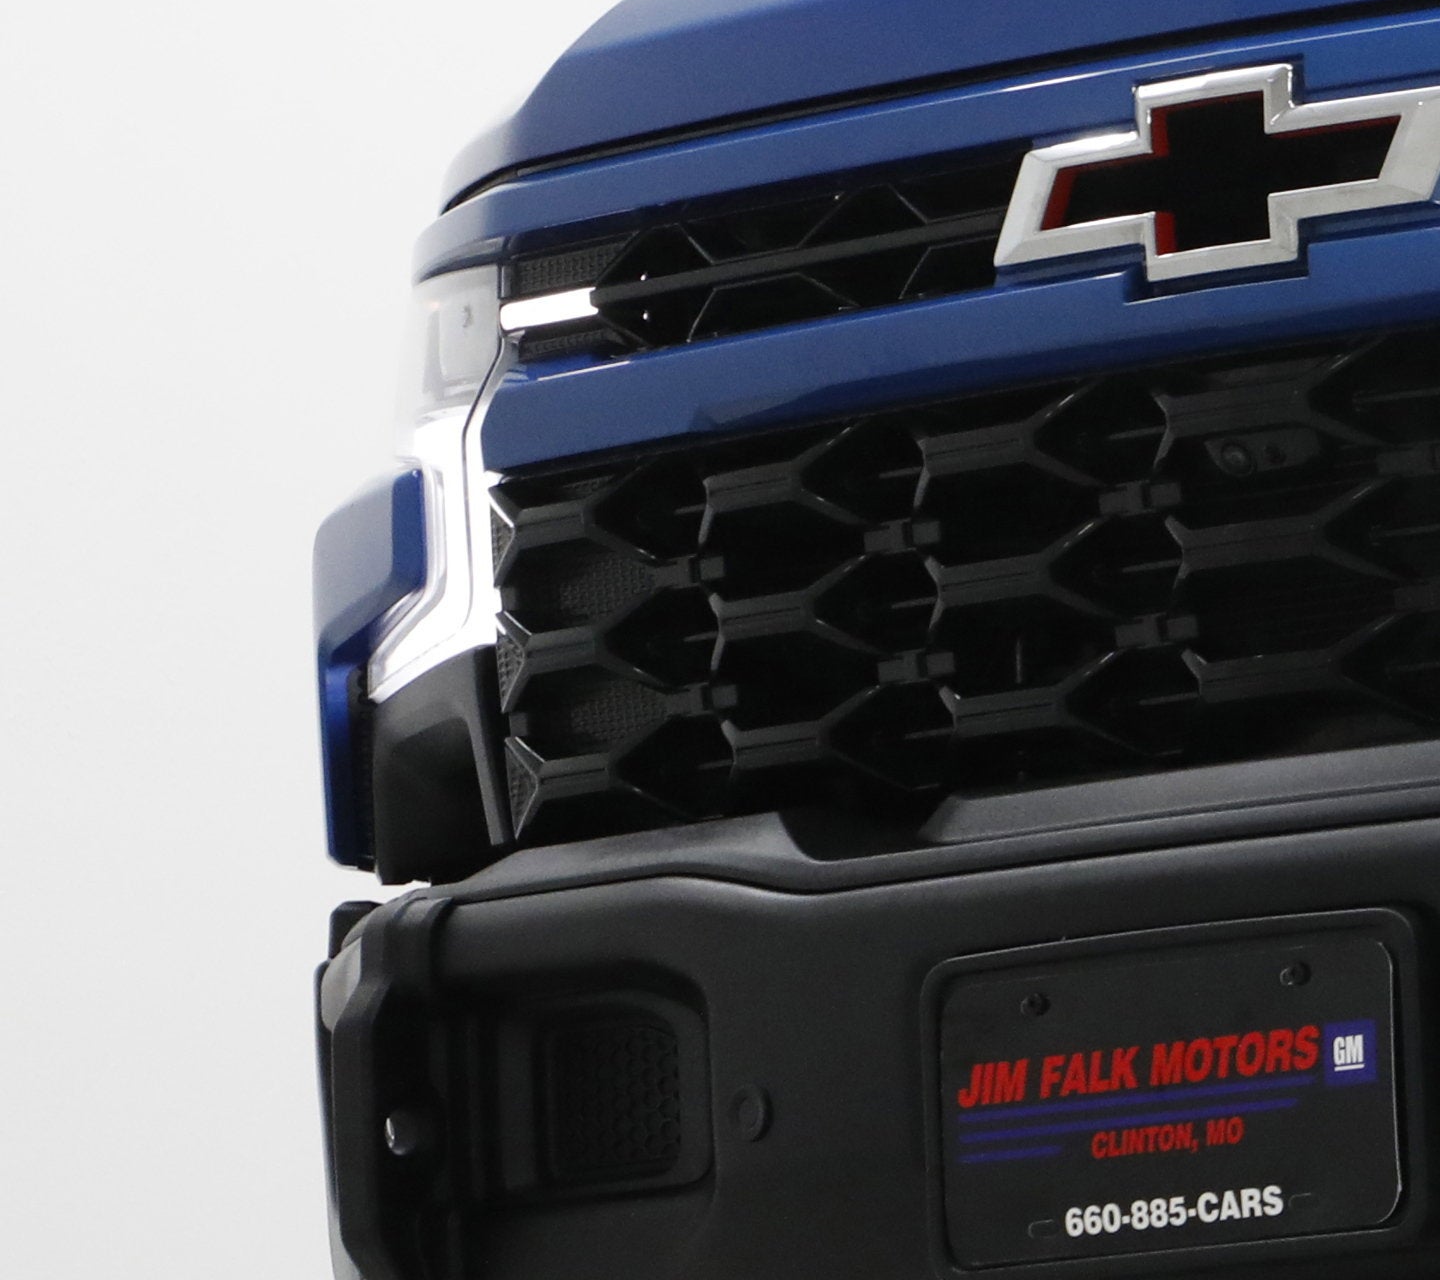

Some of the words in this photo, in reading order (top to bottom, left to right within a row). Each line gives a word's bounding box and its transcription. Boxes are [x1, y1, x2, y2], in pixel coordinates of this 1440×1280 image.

[958, 1058, 1030, 1109] JIM
[1040, 1046, 1141, 1099] FALK
[1149, 1025, 1321, 1085] MOTORS
[1332, 1034, 1365, 1067] GM
[1091, 1120, 1200, 1159] CLINTON,
[1206, 1117, 1246, 1146] MO
[1064, 1185, 1285, 1238] 660-885-CARS
